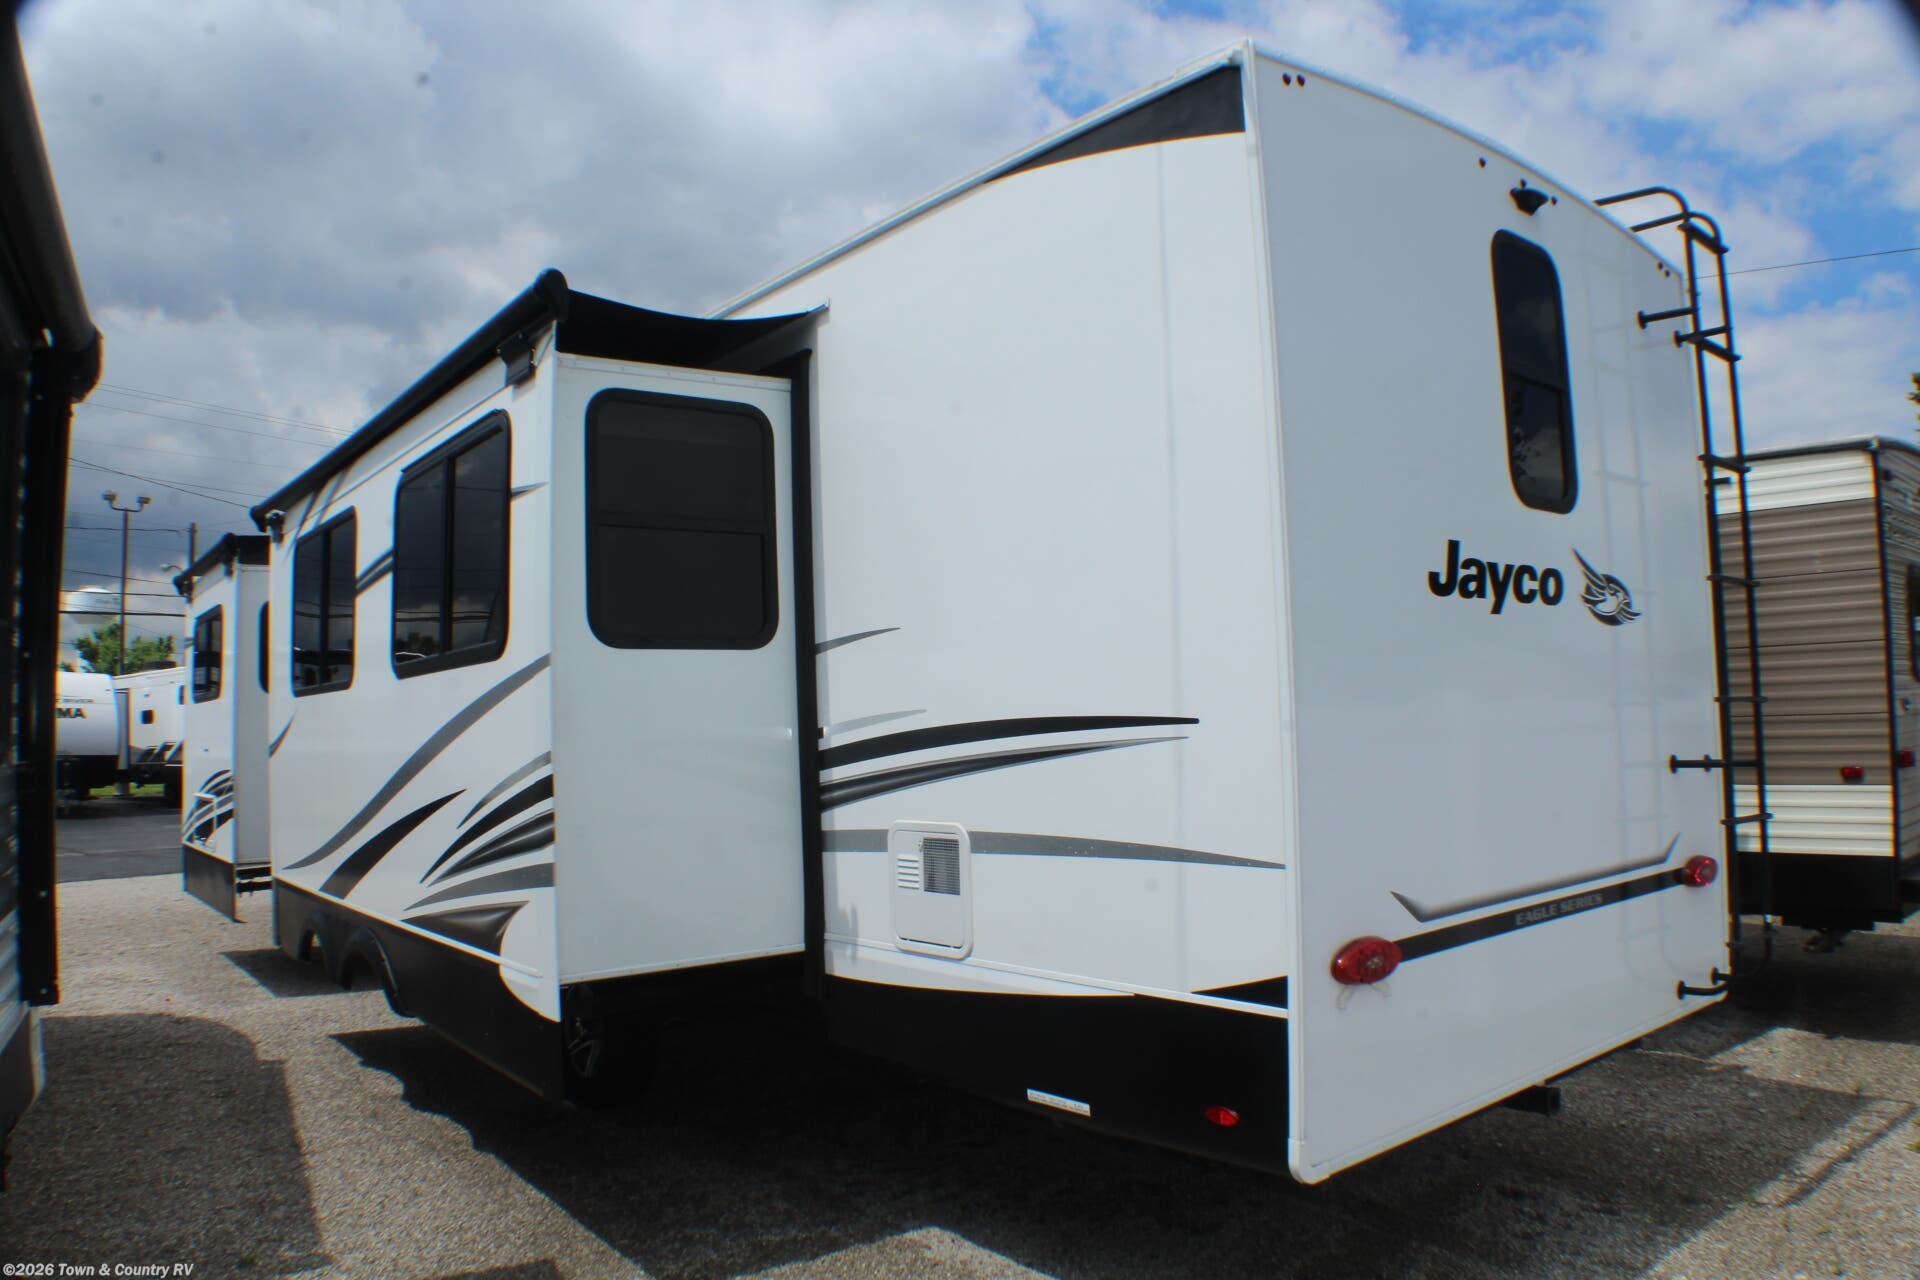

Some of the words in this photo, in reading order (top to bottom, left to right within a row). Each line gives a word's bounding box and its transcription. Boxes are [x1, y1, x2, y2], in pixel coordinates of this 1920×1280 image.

[1428, 539, 1564, 615] Jayco
[1515, 904, 1558, 926] EAGLE
[1560, 893, 1604, 913] SERIES
